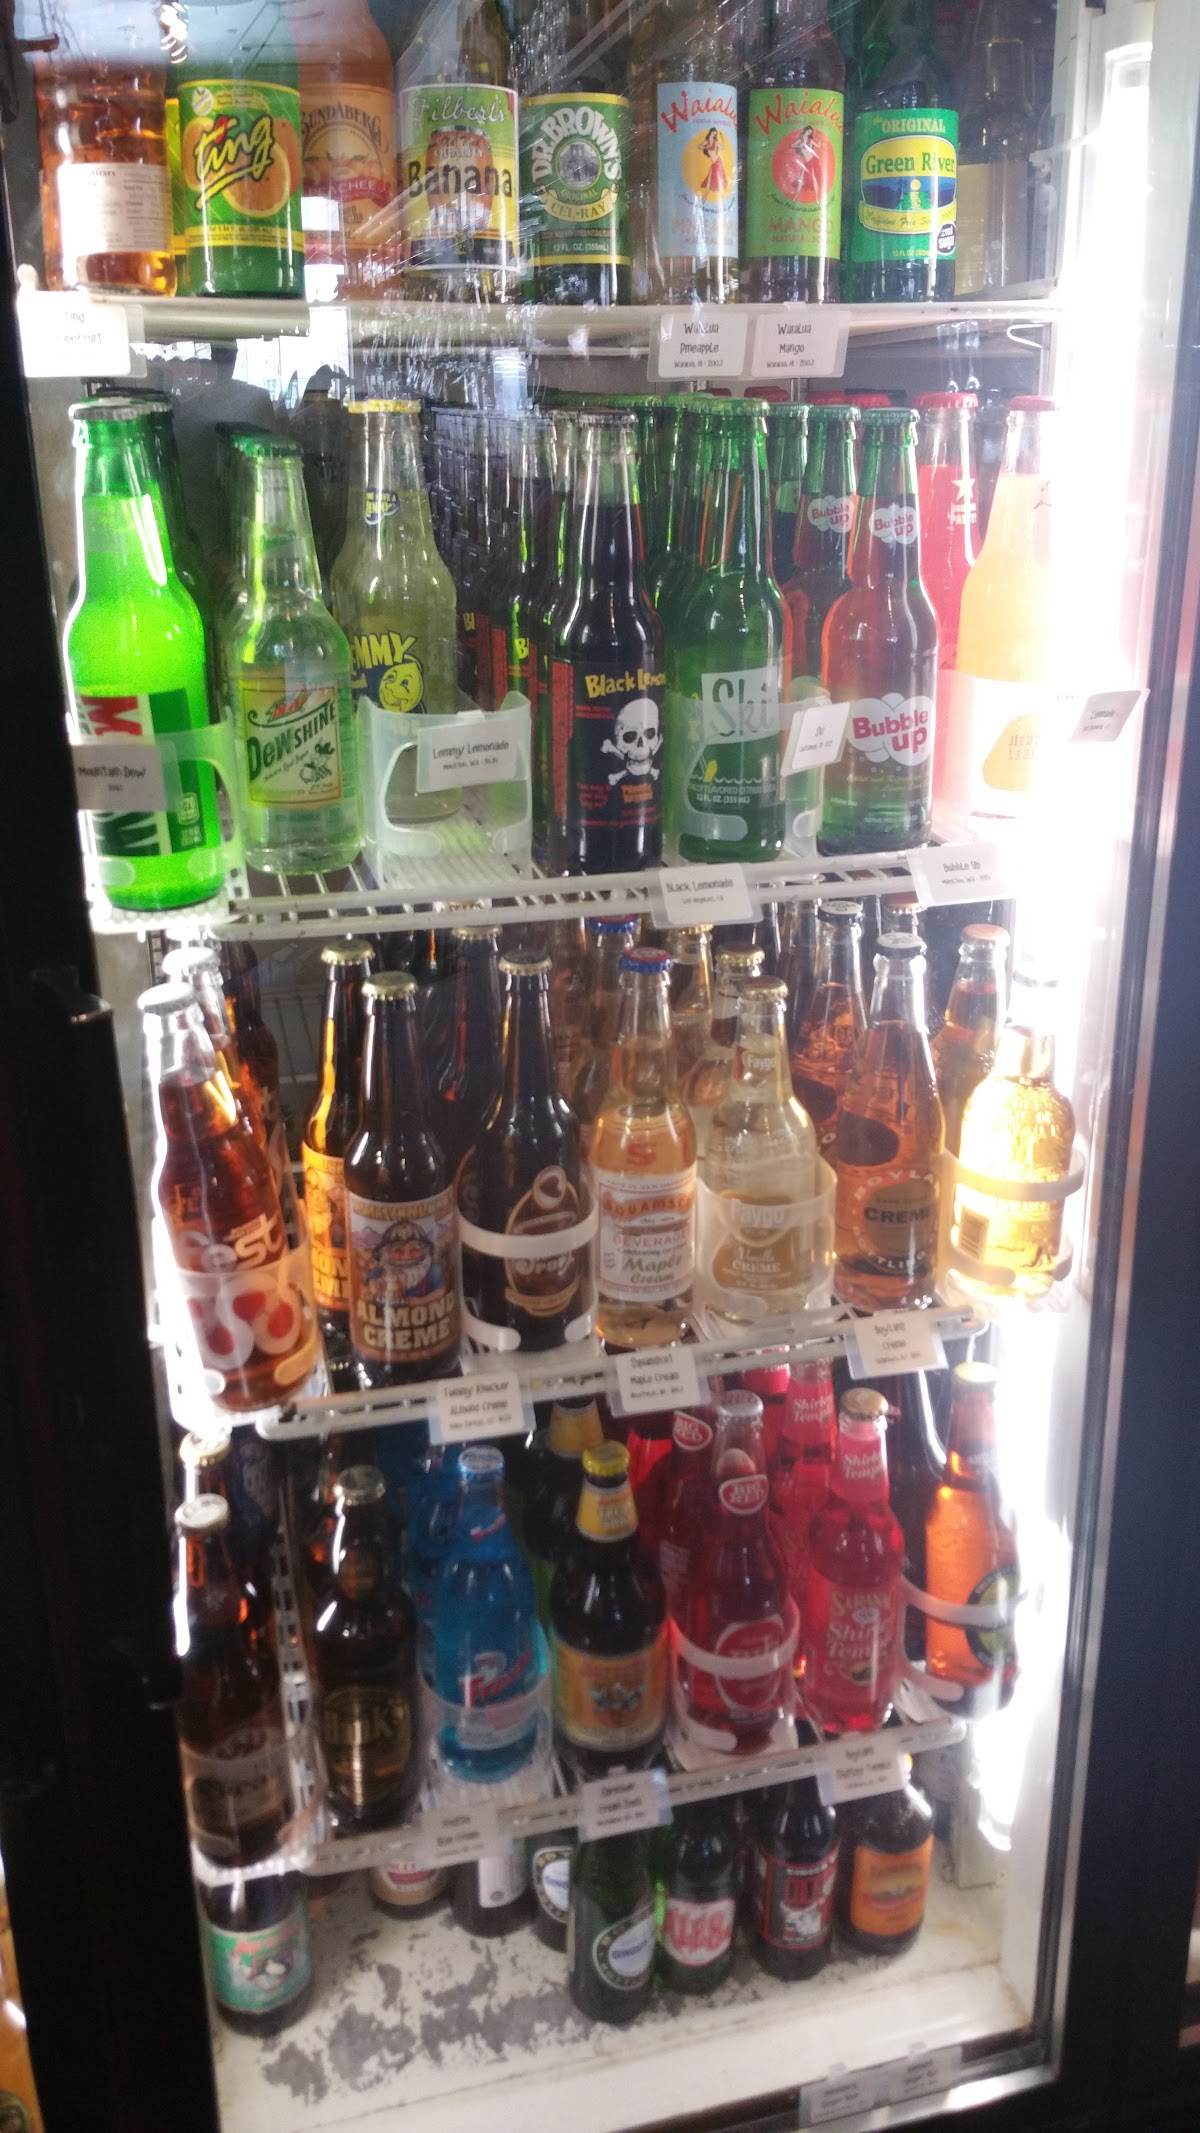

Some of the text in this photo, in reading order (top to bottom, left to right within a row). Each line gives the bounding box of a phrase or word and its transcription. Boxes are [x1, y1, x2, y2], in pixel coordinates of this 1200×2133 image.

[881, 118, 946, 133] ORIGINAL
[865, 152, 955, 174] Green River
[408, 160, 512, 198] Banana
[768, 217, 834, 234] MANGO
[779, 343, 805, 355] Mango
[811, 504, 849, 520] Bubble
[829, 513, 849, 527] up
[874, 513, 913, 531] Bubble
[895, 524, 913, 538] up
[585, 671, 636, 698] Black
[853, 709, 928, 739] Bubble
[892, 727, 927, 753] up
[363, 1317, 450, 1349] CREME
